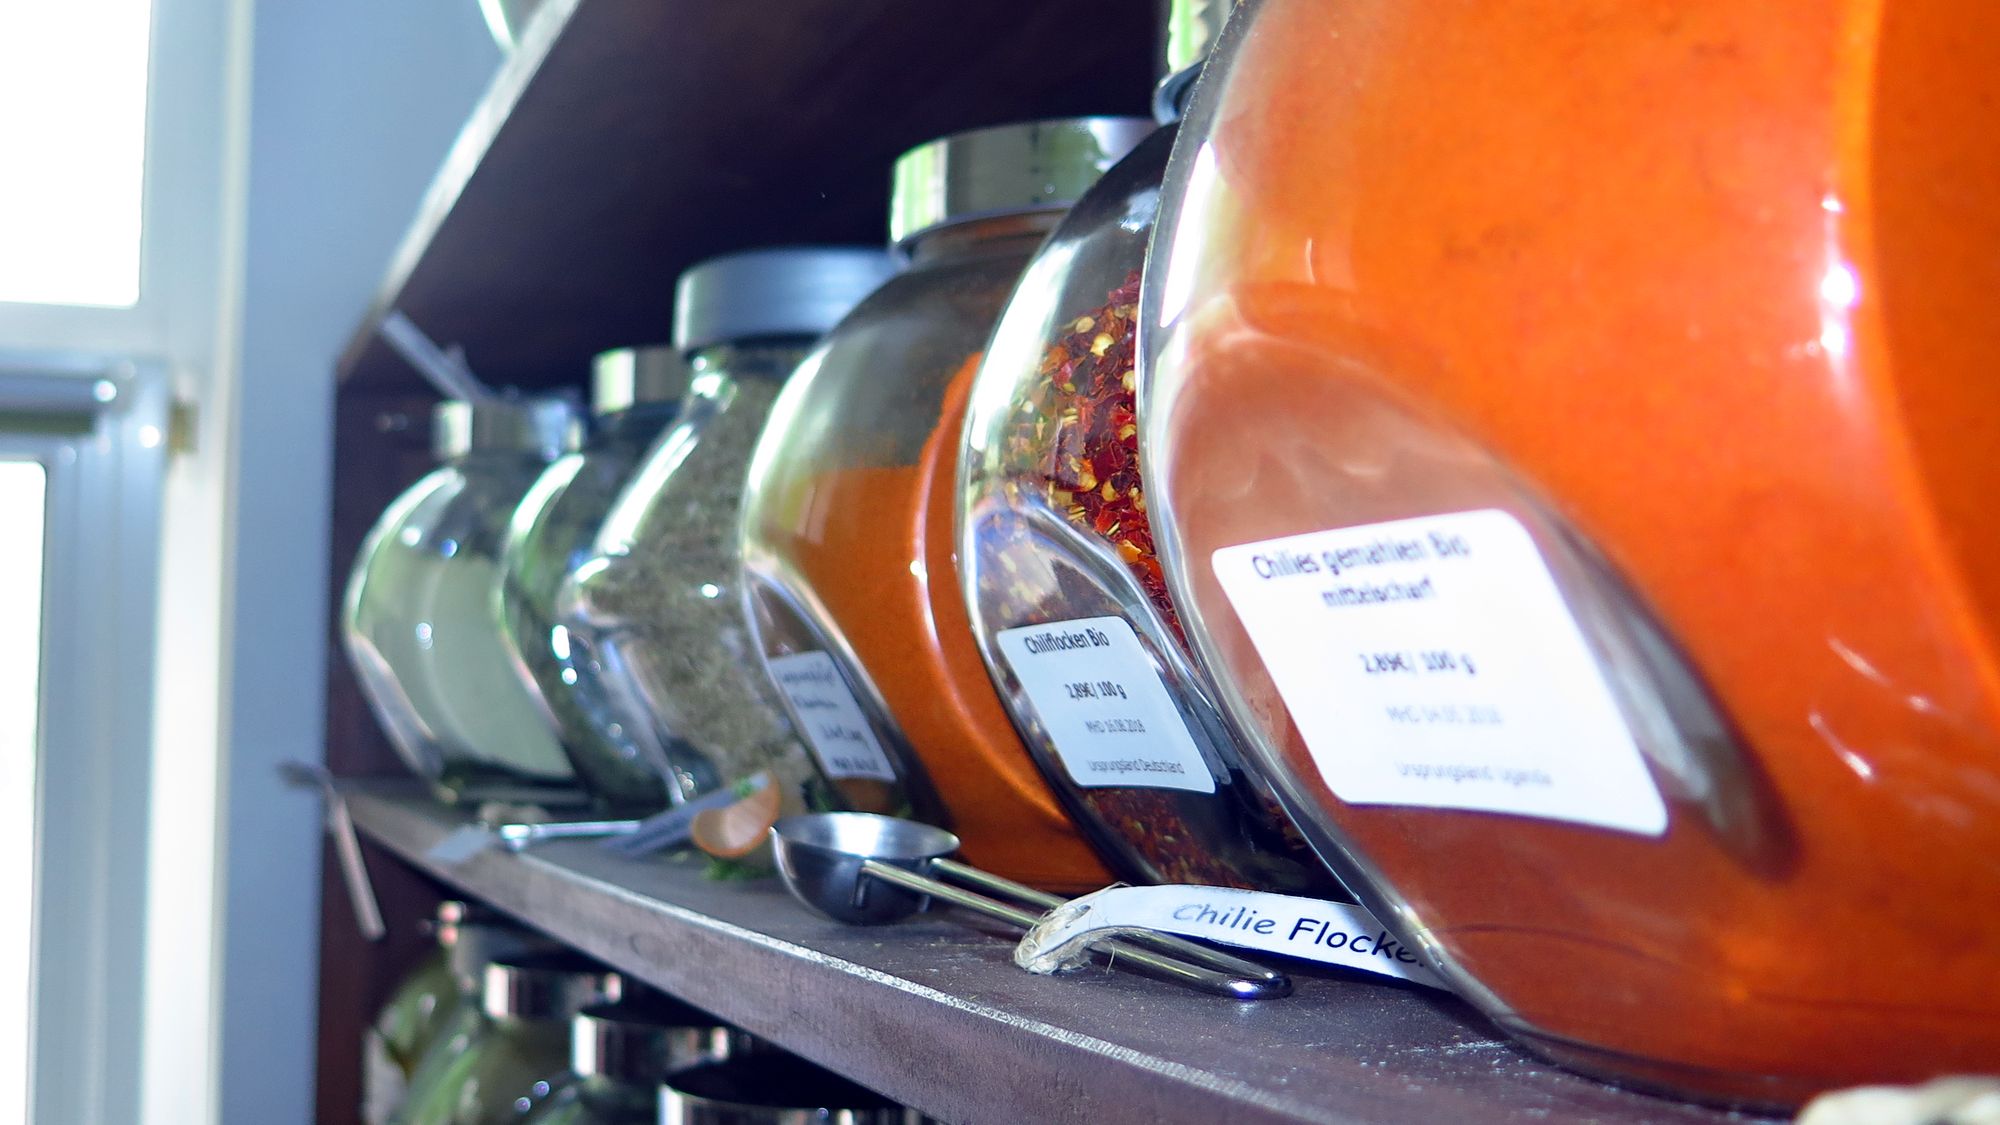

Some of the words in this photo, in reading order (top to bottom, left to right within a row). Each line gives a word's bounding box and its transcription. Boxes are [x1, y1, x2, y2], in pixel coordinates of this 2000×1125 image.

[1252, 550, 1319, 578] Chilies
[1024, 630, 1089, 654] Chiliflocken
[1086, 628, 1110, 648] Bio
[1097, 680, 1118, 697] 100
[1116, 683, 1128, 700] g
[1172, 903, 1277, 935] Chilie
